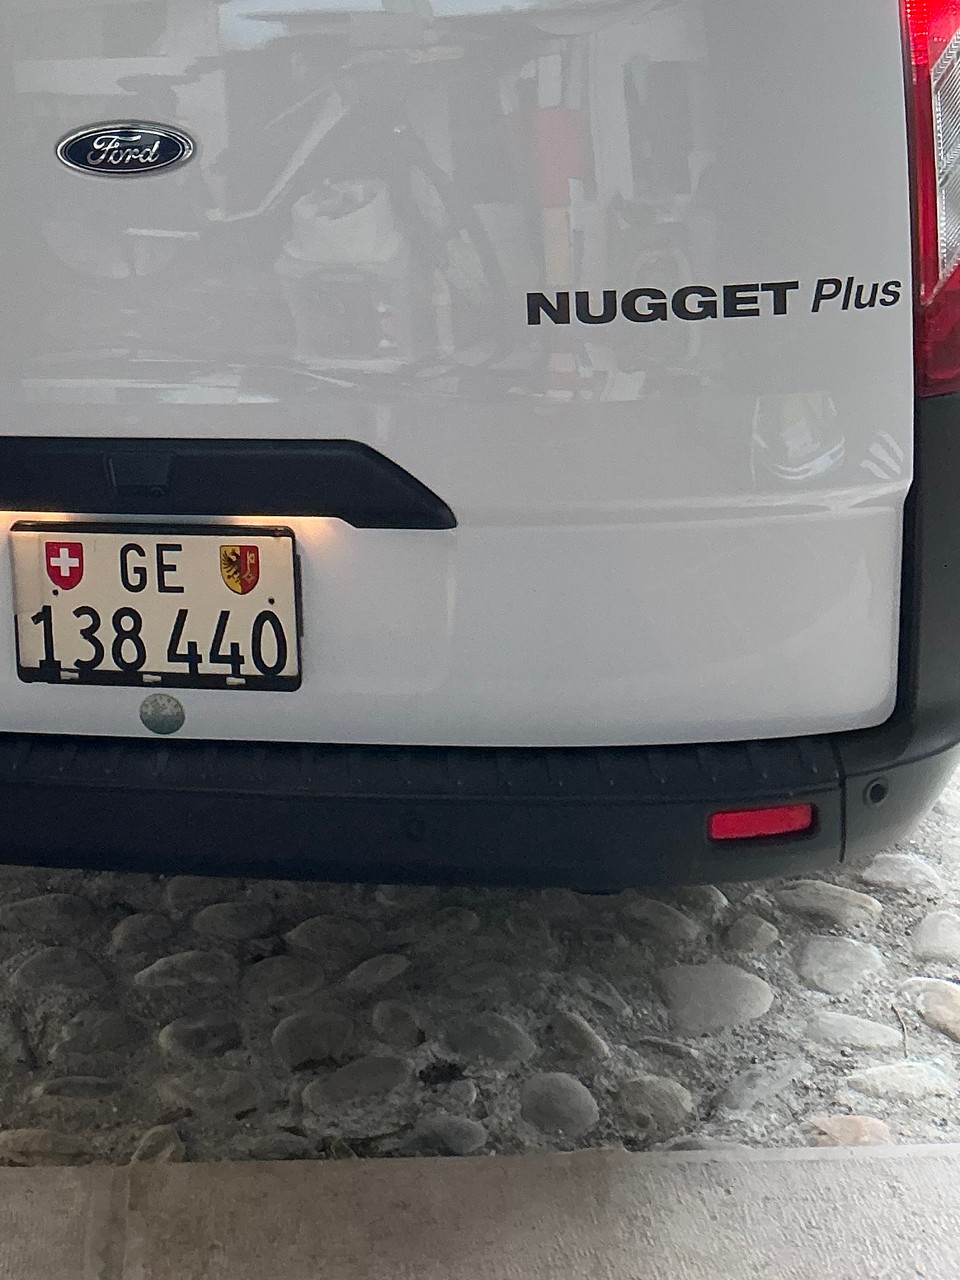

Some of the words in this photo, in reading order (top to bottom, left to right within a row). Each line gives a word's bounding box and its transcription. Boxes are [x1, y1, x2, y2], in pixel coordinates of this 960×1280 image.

[86, 134, 161, 165] Ford
[526, 280, 799, 325] NUGGET
[811, 276, 902, 313] Plus
[120, 543, 185, 593] GE
[31, 605, 147, 671] 138
[167, 609, 288, 677] 440
